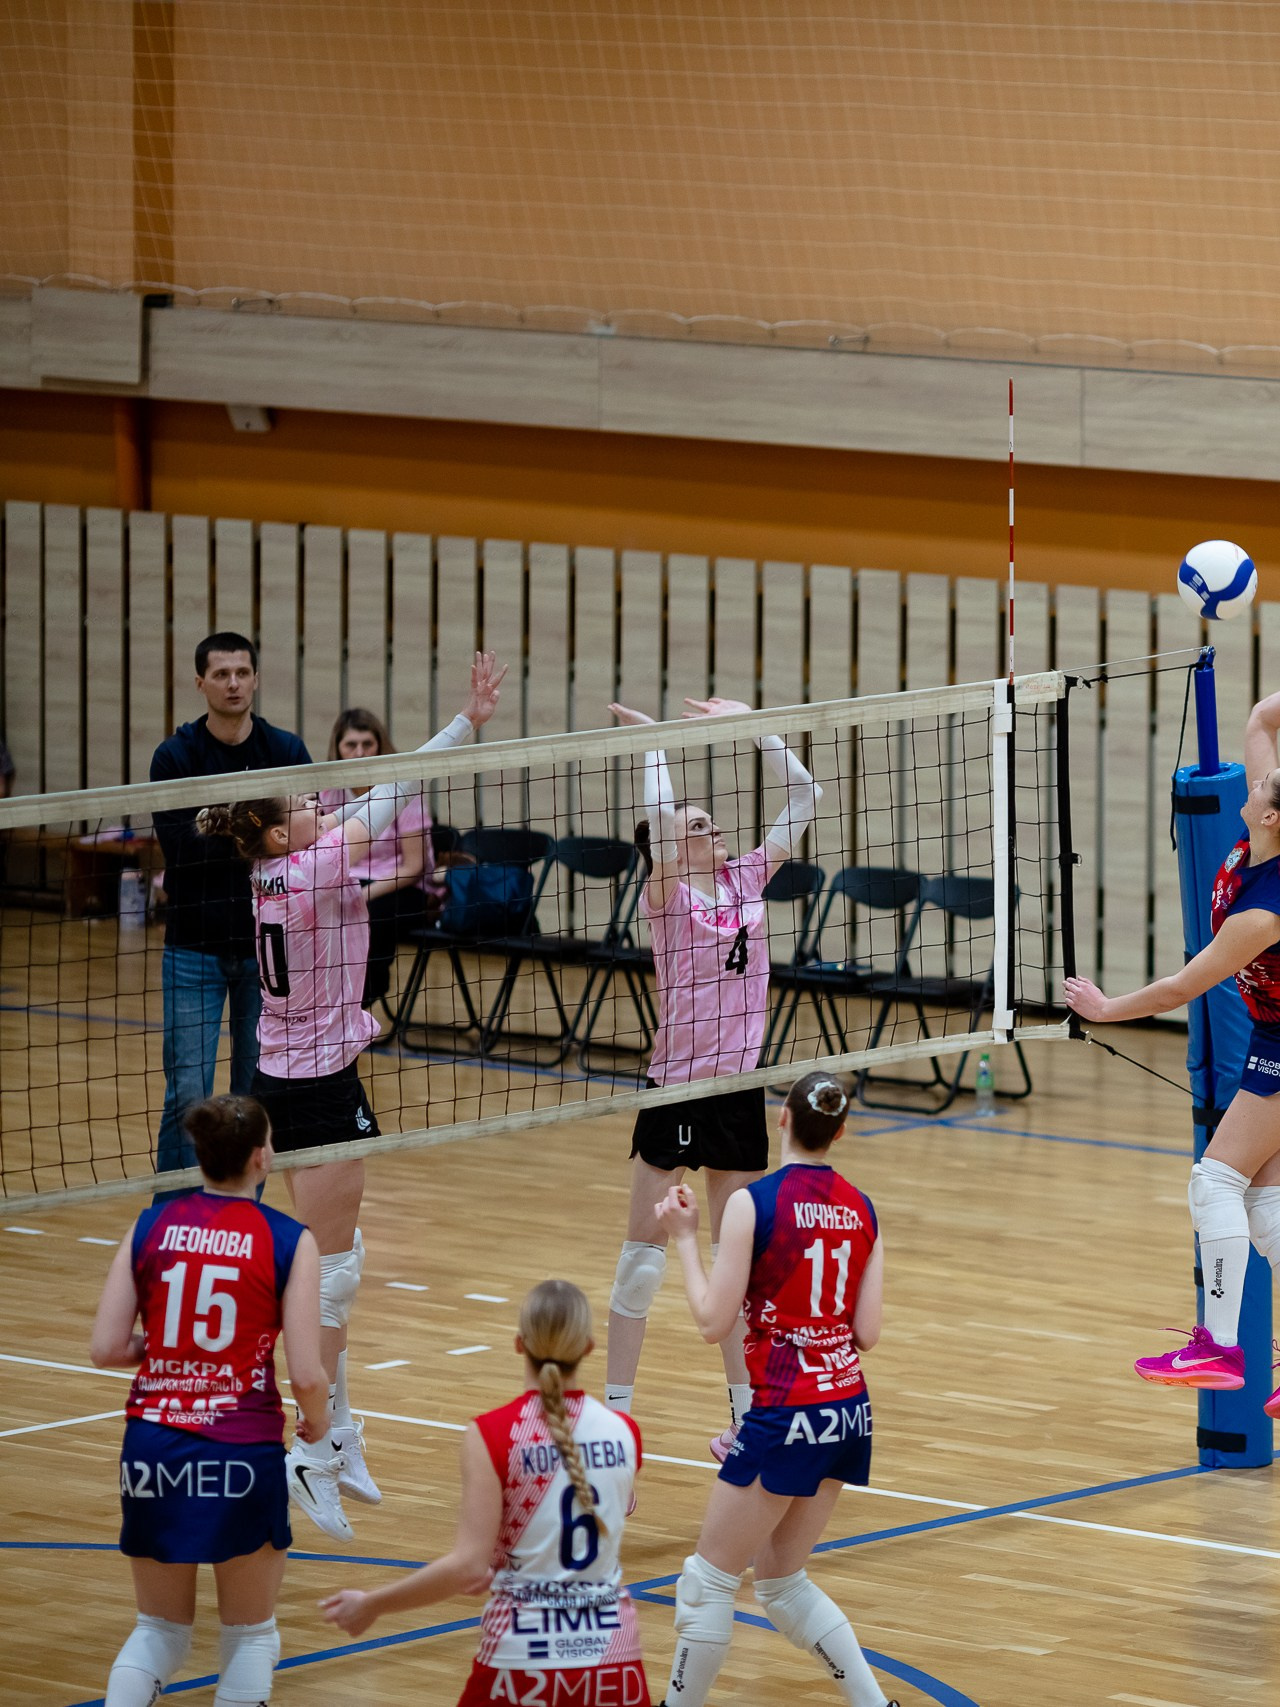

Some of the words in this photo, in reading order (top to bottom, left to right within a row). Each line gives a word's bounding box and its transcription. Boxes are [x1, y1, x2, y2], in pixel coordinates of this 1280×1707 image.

[725, 925, 749, 975] 4
[793, 1202, 863, 1230] КОЧНЕВА
[158, 1225, 253, 1260] ЛЕОНОВА
[804, 1238, 852, 1318] 11
[161, 1261, 240, 1352] 15
[148, 1357, 234, 1378] ИСКРА
[166, 1415, 214, 1426] VISION
[521, 1440, 626, 1475] КОРЛЕВА
[121, 1460, 256, 1498] A2MED
[560, 1483, 600, 1571] 6
[511, 1606, 621, 1635] LIME
[554, 1637, 611, 1649] GLOBAL
[555, 1647, 606, 1658] VISION
[489, 1665, 643, 1707] A2MED
